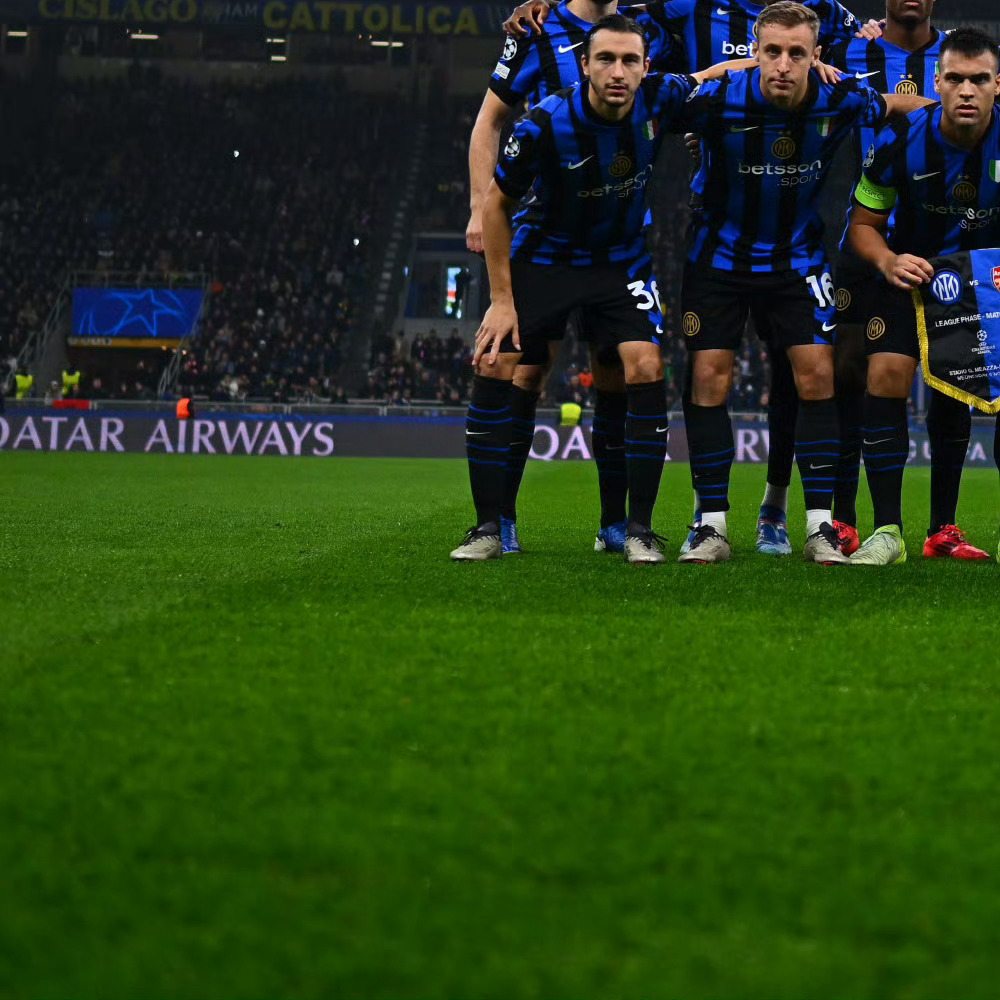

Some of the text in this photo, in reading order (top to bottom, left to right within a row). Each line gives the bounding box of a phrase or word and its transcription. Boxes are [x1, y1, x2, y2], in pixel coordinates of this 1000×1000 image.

[263, 0, 479, 35] CATTOLICA
[737, 160, 822, 175] betsson
[805, 272, 836, 308] 16
[935, 318, 960, 327] LEAGUE
[960, 313, 982, 323] PHASE
[949, 368, 967, 376] STADIO
[144, 418, 335, 457] AIRWAYS
